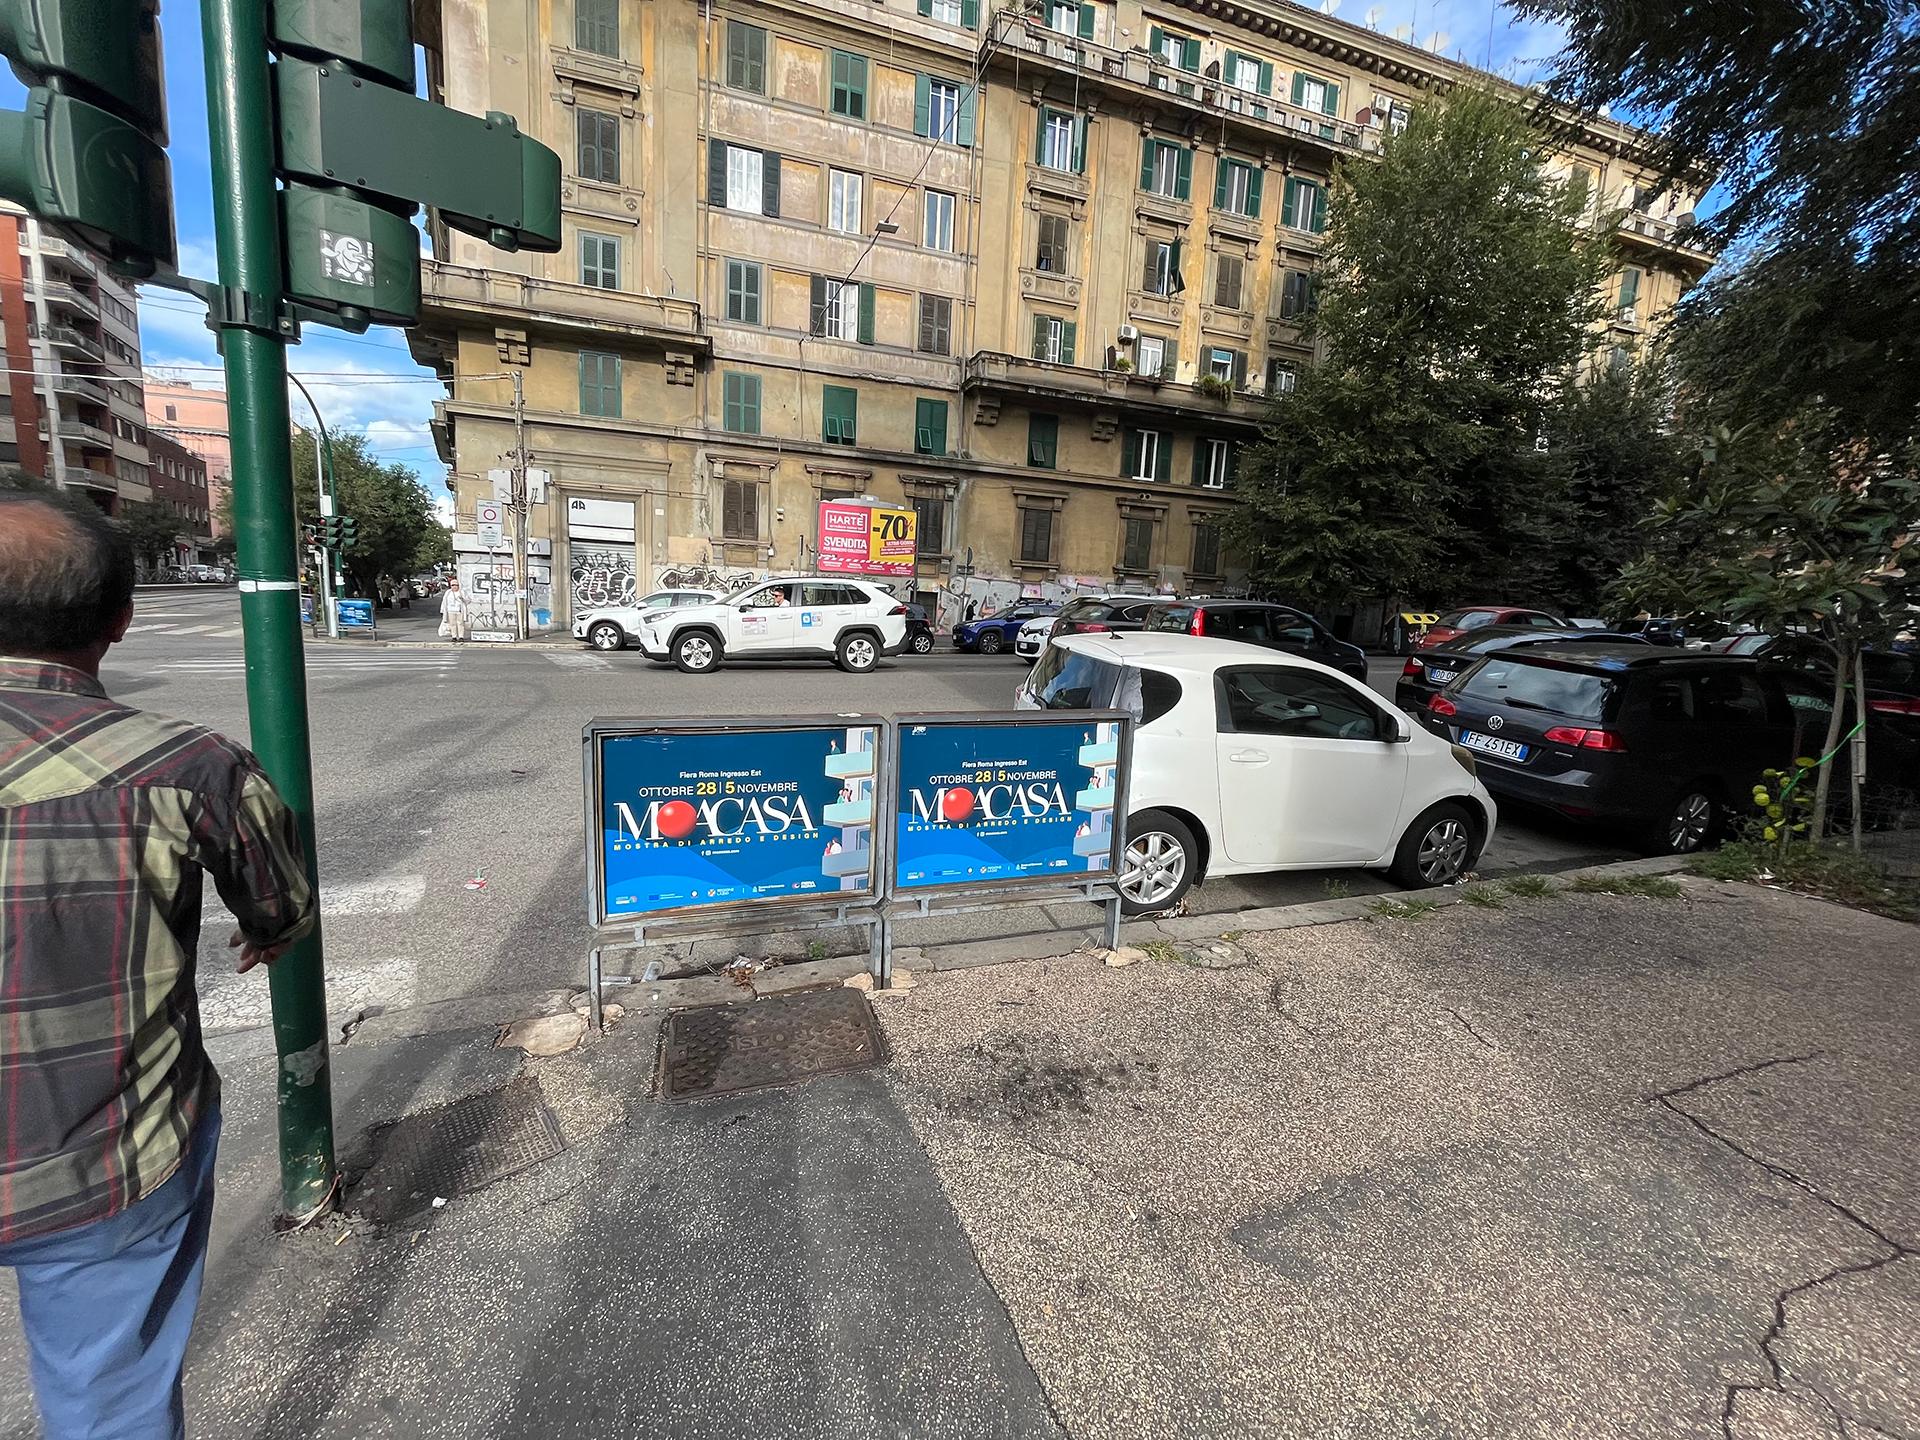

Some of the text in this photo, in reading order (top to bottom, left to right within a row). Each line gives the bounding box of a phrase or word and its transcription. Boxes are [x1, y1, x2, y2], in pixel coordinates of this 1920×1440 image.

[823, 536, 867, 549] SVENDITA
[1468, 732, 1521, 756] FF 451EX
[994, 760, 1017, 768] Ingresso
[679, 769, 762, 779] Fiera Roma Ingresso Est
[929, 770, 1057, 784] OTTOBRE 28 5 NOVEMBRE
[639, 781, 798, 797] OTTOBRE 28 5 NOVEMBRE
[907, 824, 951, 832] MOSTRA
[976, 819, 1017, 828] ARREDO
[1035, 816, 1072, 824] DESIGN
[613, 841, 669, 851] MOSTRA
[700, 836, 751, 846] ARREDO
[774, 832, 819, 841] DESIGN
